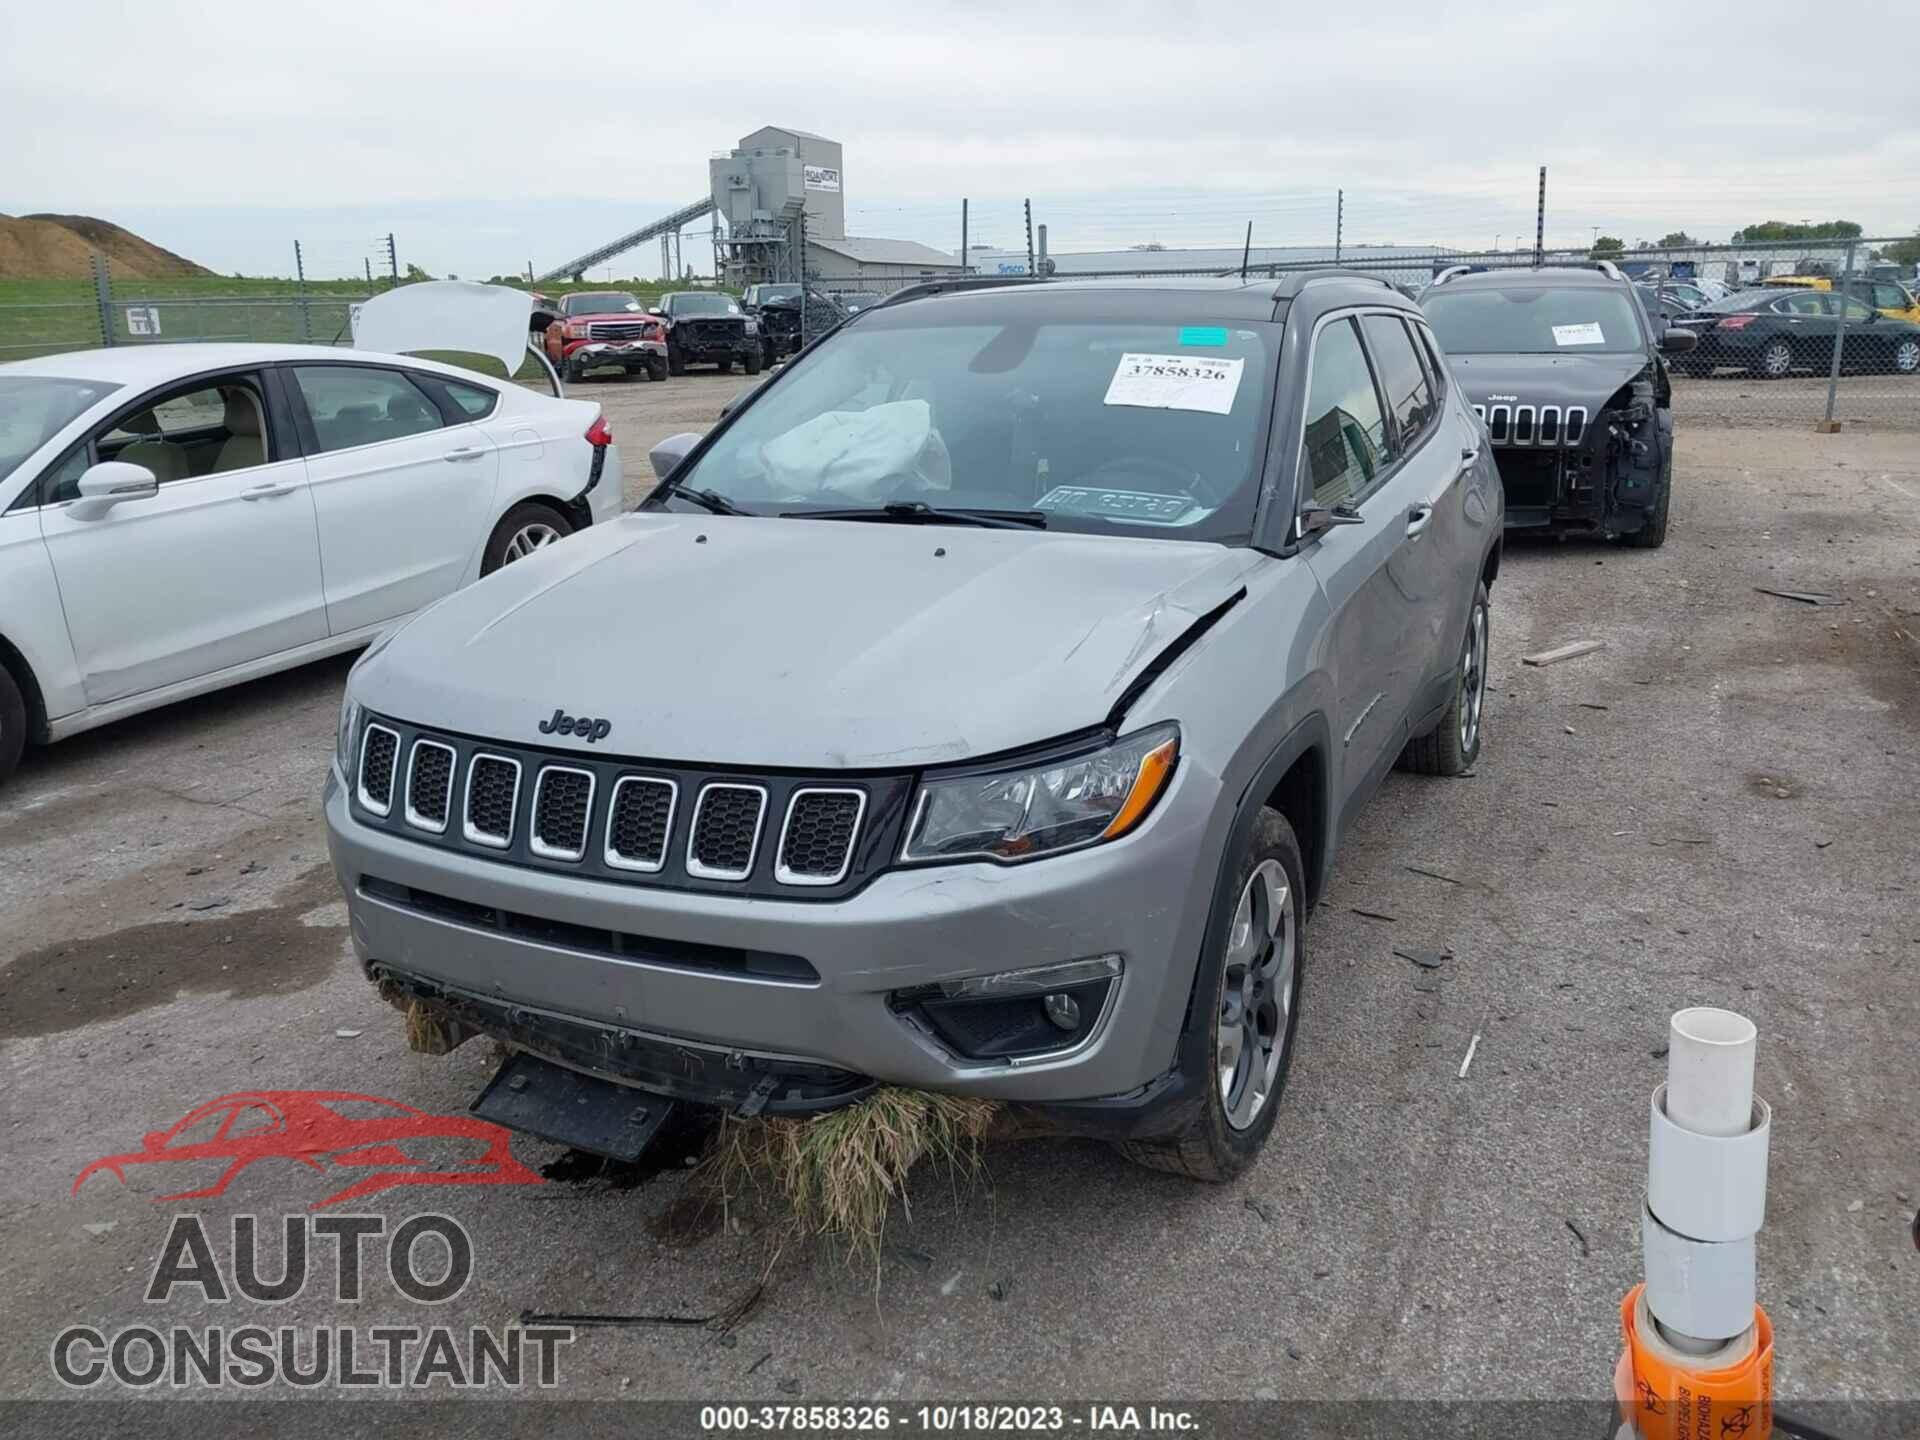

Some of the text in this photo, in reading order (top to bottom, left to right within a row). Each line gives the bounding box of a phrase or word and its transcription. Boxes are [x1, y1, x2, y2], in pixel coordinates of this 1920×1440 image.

[1128, 365, 1226, 381] 37858326
[1487, 394, 1518, 402] Jeep
[538, 708, 612, 743] Jeep
